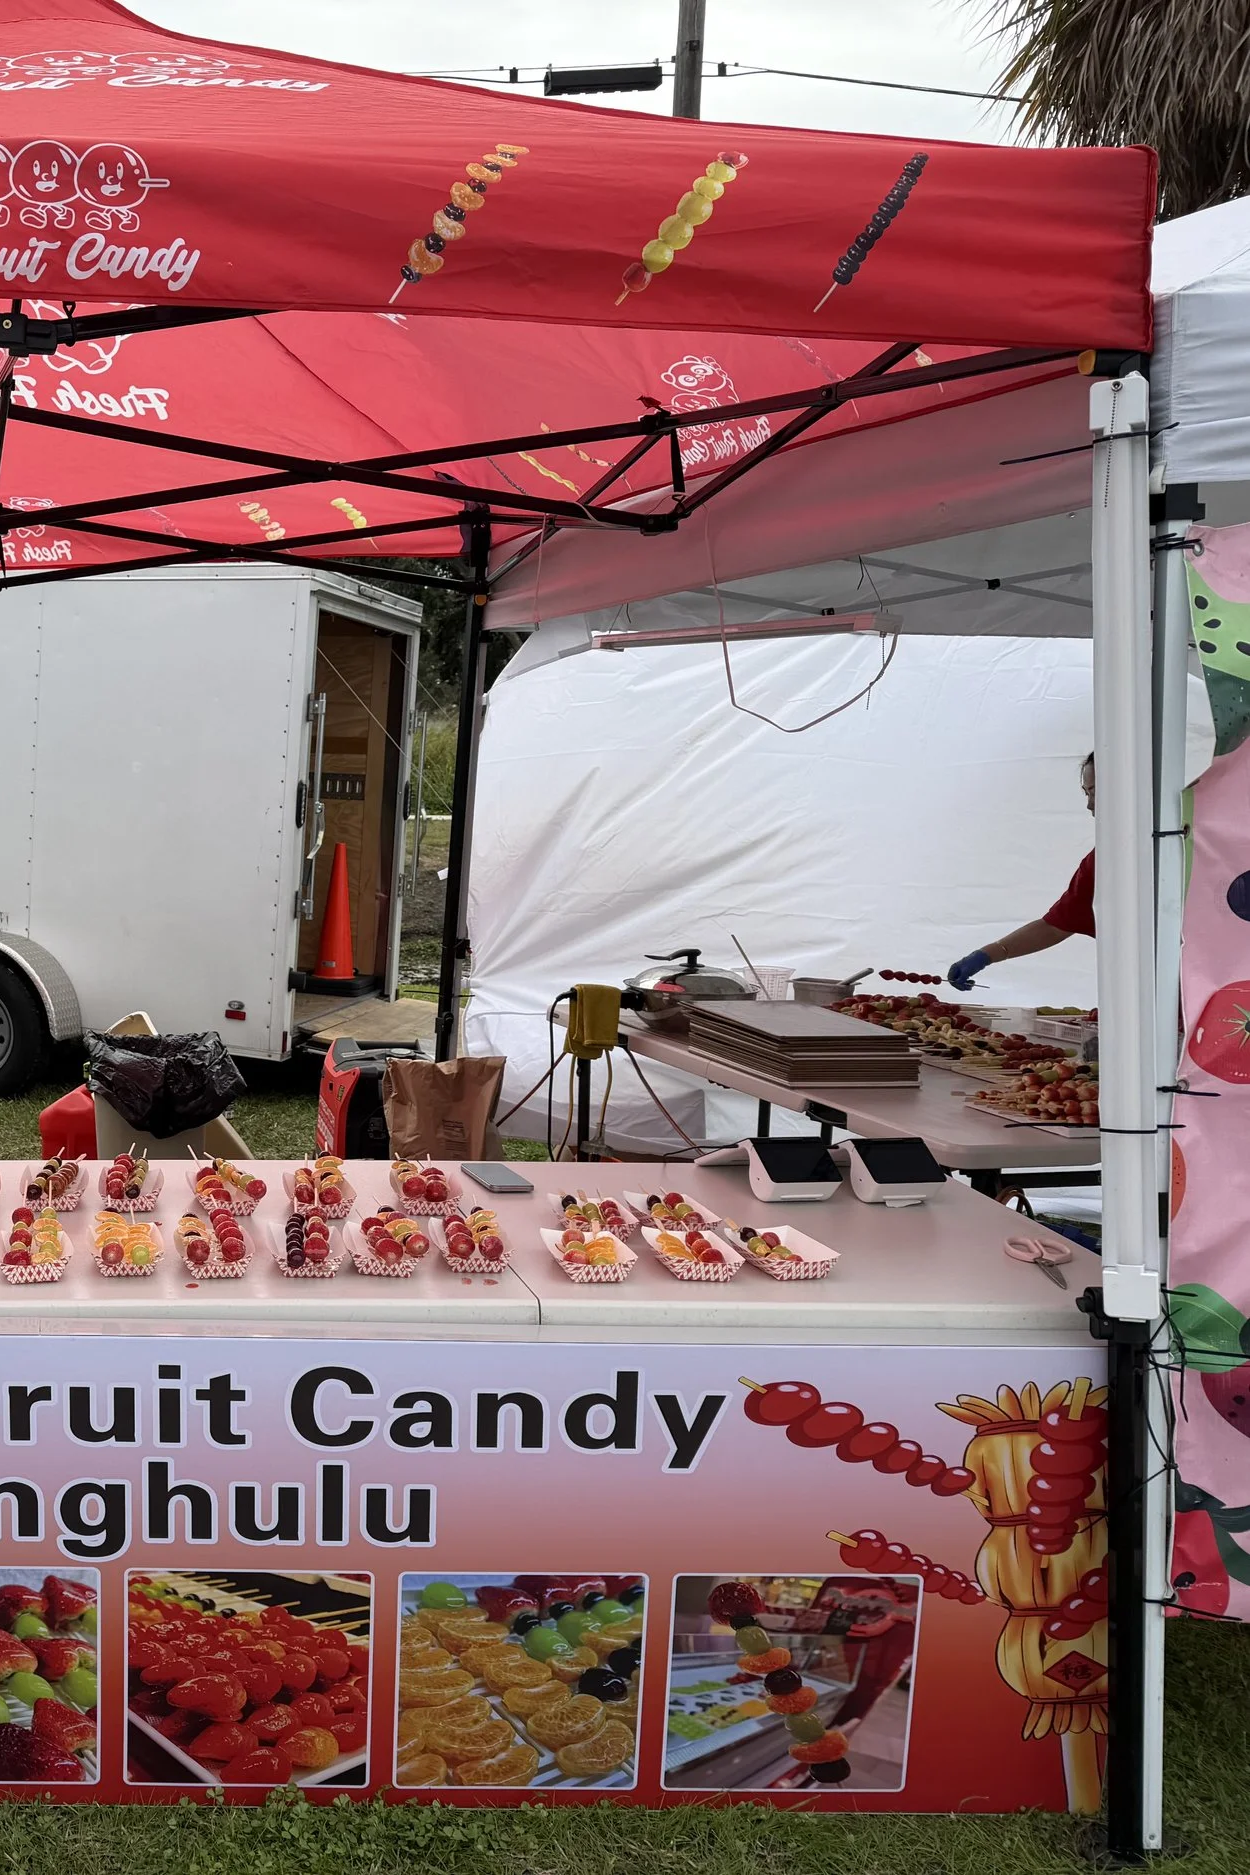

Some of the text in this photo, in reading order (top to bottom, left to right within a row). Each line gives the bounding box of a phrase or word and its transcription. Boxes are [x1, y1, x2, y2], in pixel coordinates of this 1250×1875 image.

[106, 74, 331, 93] Candy
[65, 232, 201, 292] Candy
[289, 1365, 728, 1470] Candy
